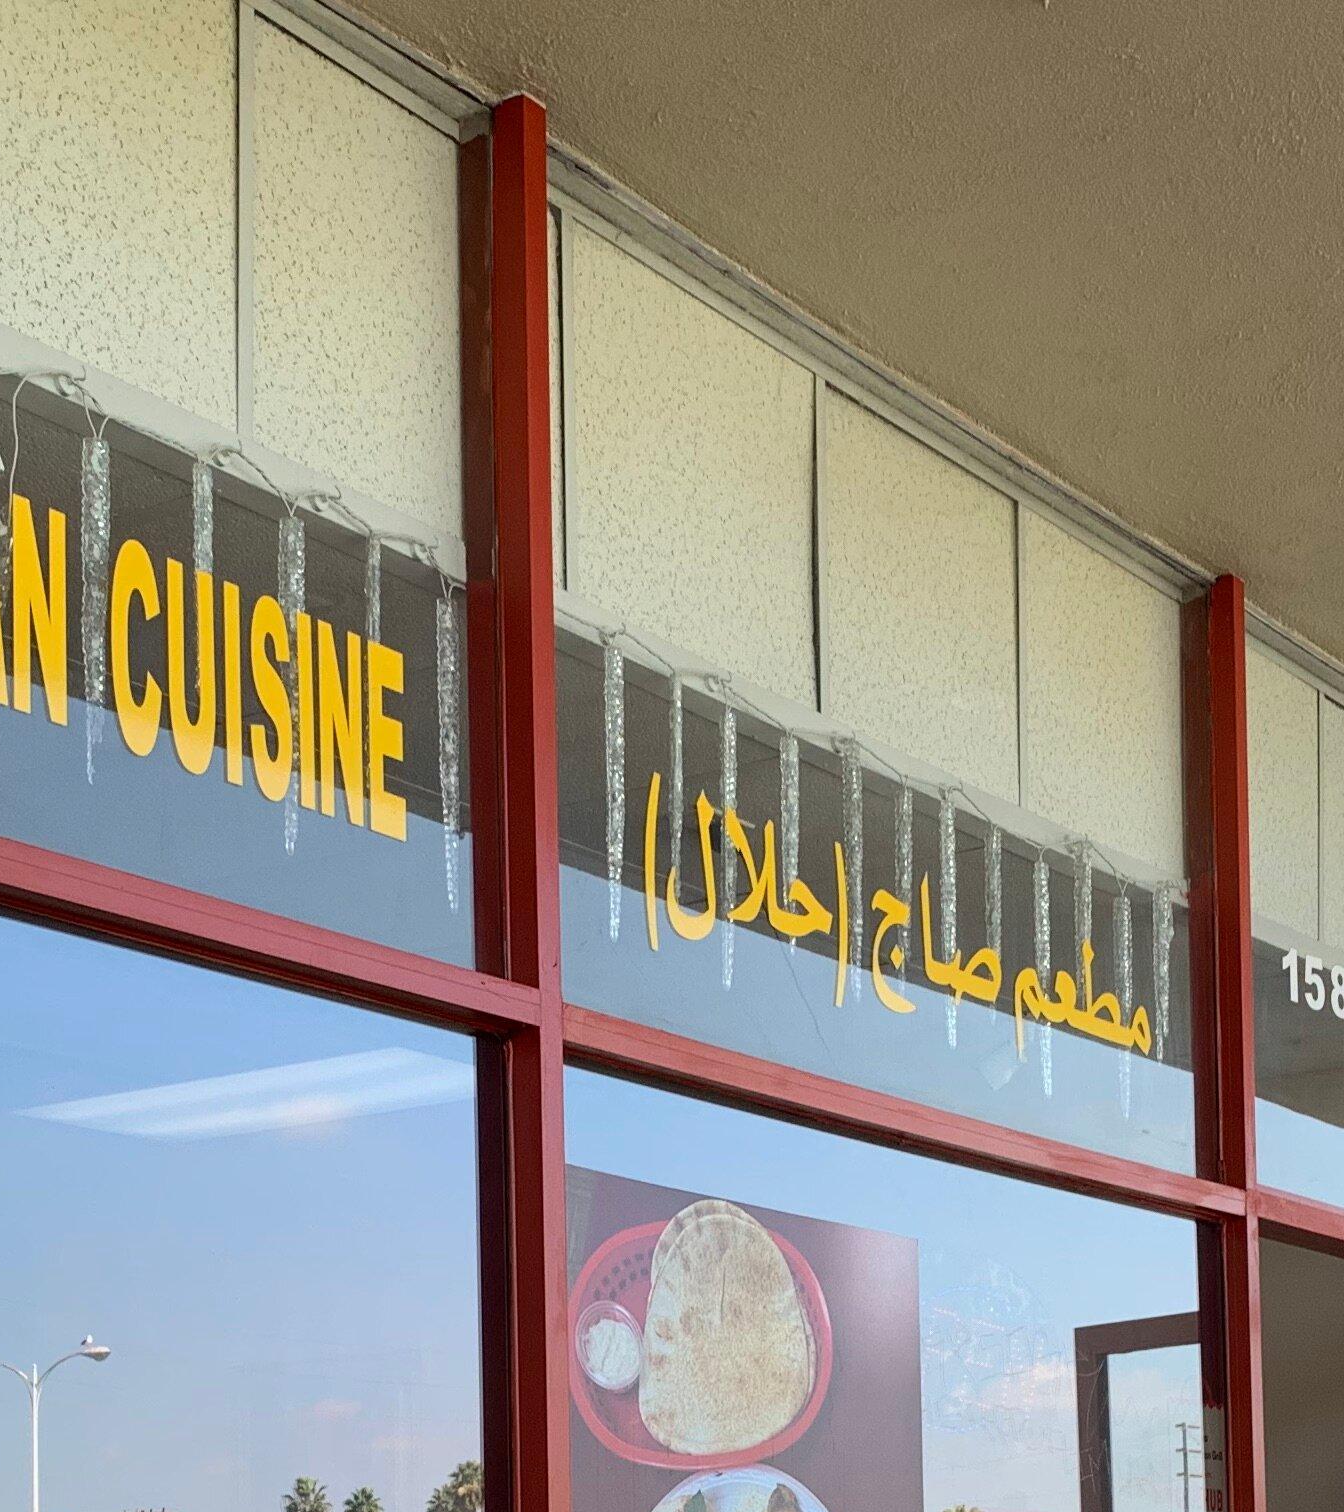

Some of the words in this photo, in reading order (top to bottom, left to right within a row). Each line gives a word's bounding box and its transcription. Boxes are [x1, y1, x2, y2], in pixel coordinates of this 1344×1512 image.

[111, 538, 408, 842] CUISINE
[871, 872, 1003, 1014] صاج
[1014, 939, 1153, 1061] مطعم
